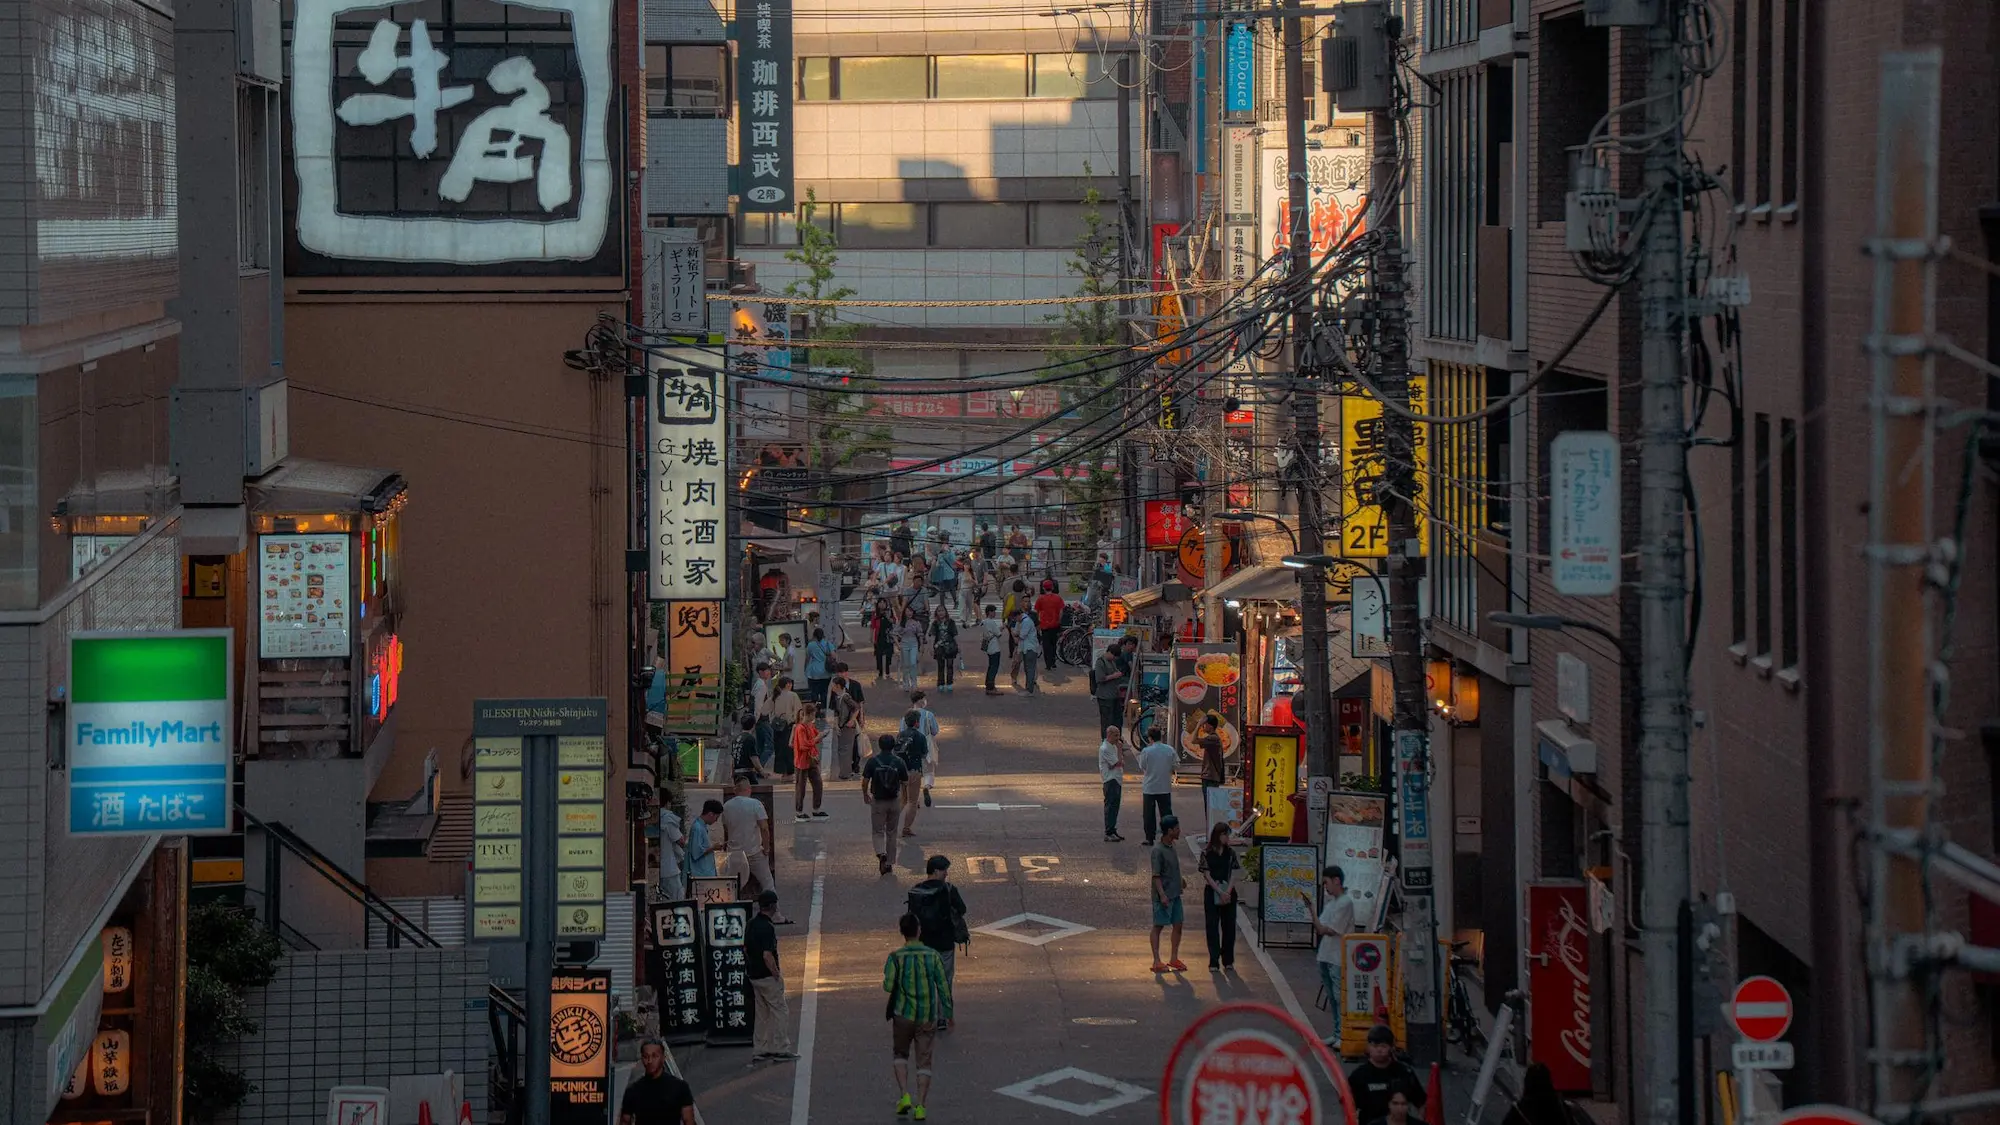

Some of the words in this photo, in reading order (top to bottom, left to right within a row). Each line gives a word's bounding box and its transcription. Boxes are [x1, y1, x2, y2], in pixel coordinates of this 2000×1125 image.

[757, 3, 772, 48] 純喫茶
[336, 19, 571, 212] 牛角
[752, 59, 780, 178] 珈琲西武
[1234, 144, 1243, 171] STUDIO
[757, 189, 777, 200] 2階
[1234, 173, 1243, 197] BEANS
[1234, 199, 1243, 210] 717
[670, 248, 683, 309] ギャラリー
[687, 246, 699, 308] 新宿アート
[665, 378, 710, 412] 牛角
[658, 438, 675, 587] Gyu-Kaku
[682, 437, 719, 586] 焼肉酒家
[1350, 526, 1386, 549] 2F
[77, 720, 221, 748] FamilyMart
[482, 707, 531, 719] BLESSTEN
[532, 706, 598, 720] Nishi-Shinjuku
[92, 791, 125, 827] 酒
[138, 791, 206, 822] たばこ
[662, 949, 678, 1027] Gyu-Kaku
[675, 947, 701, 1026] 焼肉酒家
[712, 949, 724, 1029] Gyu-Kaku
[725, 948, 746, 1028] 焼肉酒家
[551, 1081, 598, 1092] AKINIKU
